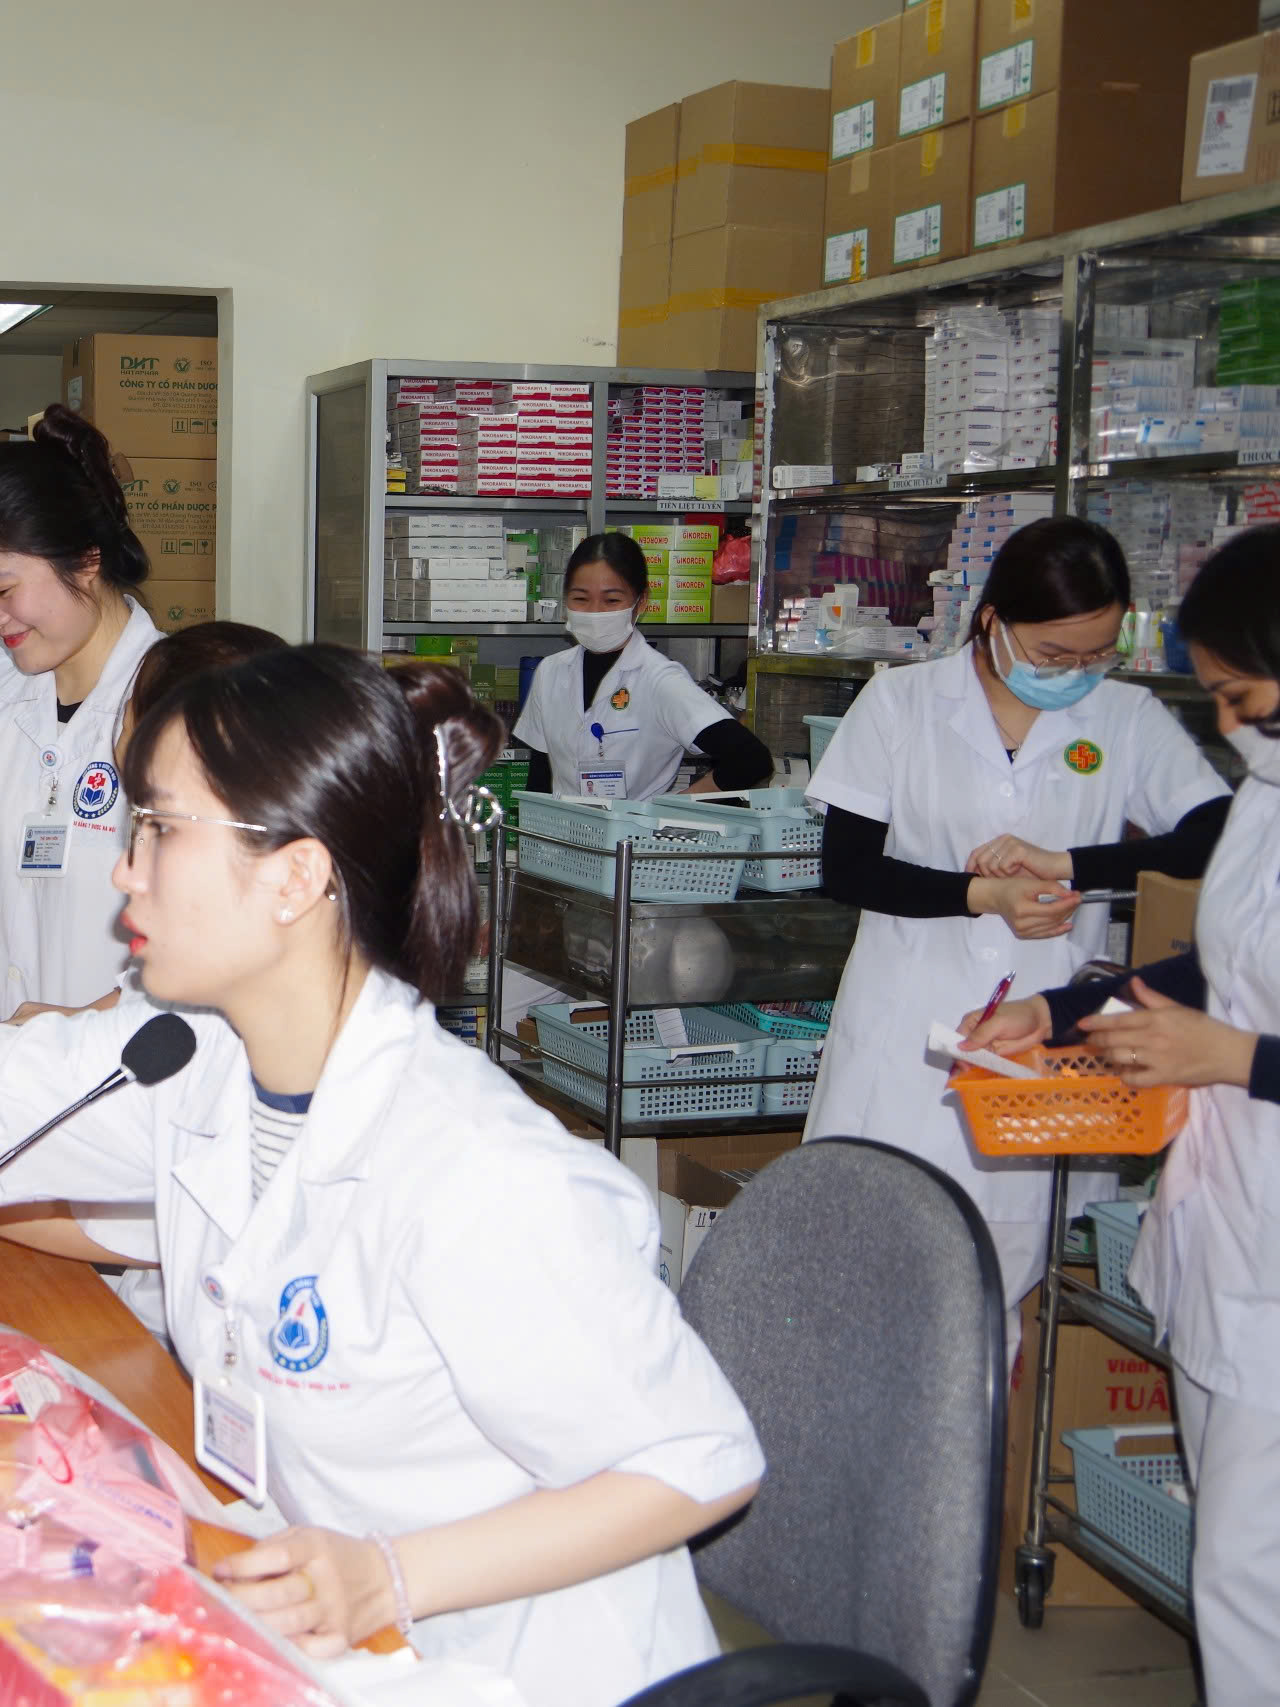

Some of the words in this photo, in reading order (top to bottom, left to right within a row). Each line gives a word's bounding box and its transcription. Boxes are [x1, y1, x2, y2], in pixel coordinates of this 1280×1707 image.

[120, 378, 144, 388] CÔNG
[146, 380, 156, 388] TY
[1105, 1376, 1168, 1411] TUẦ
